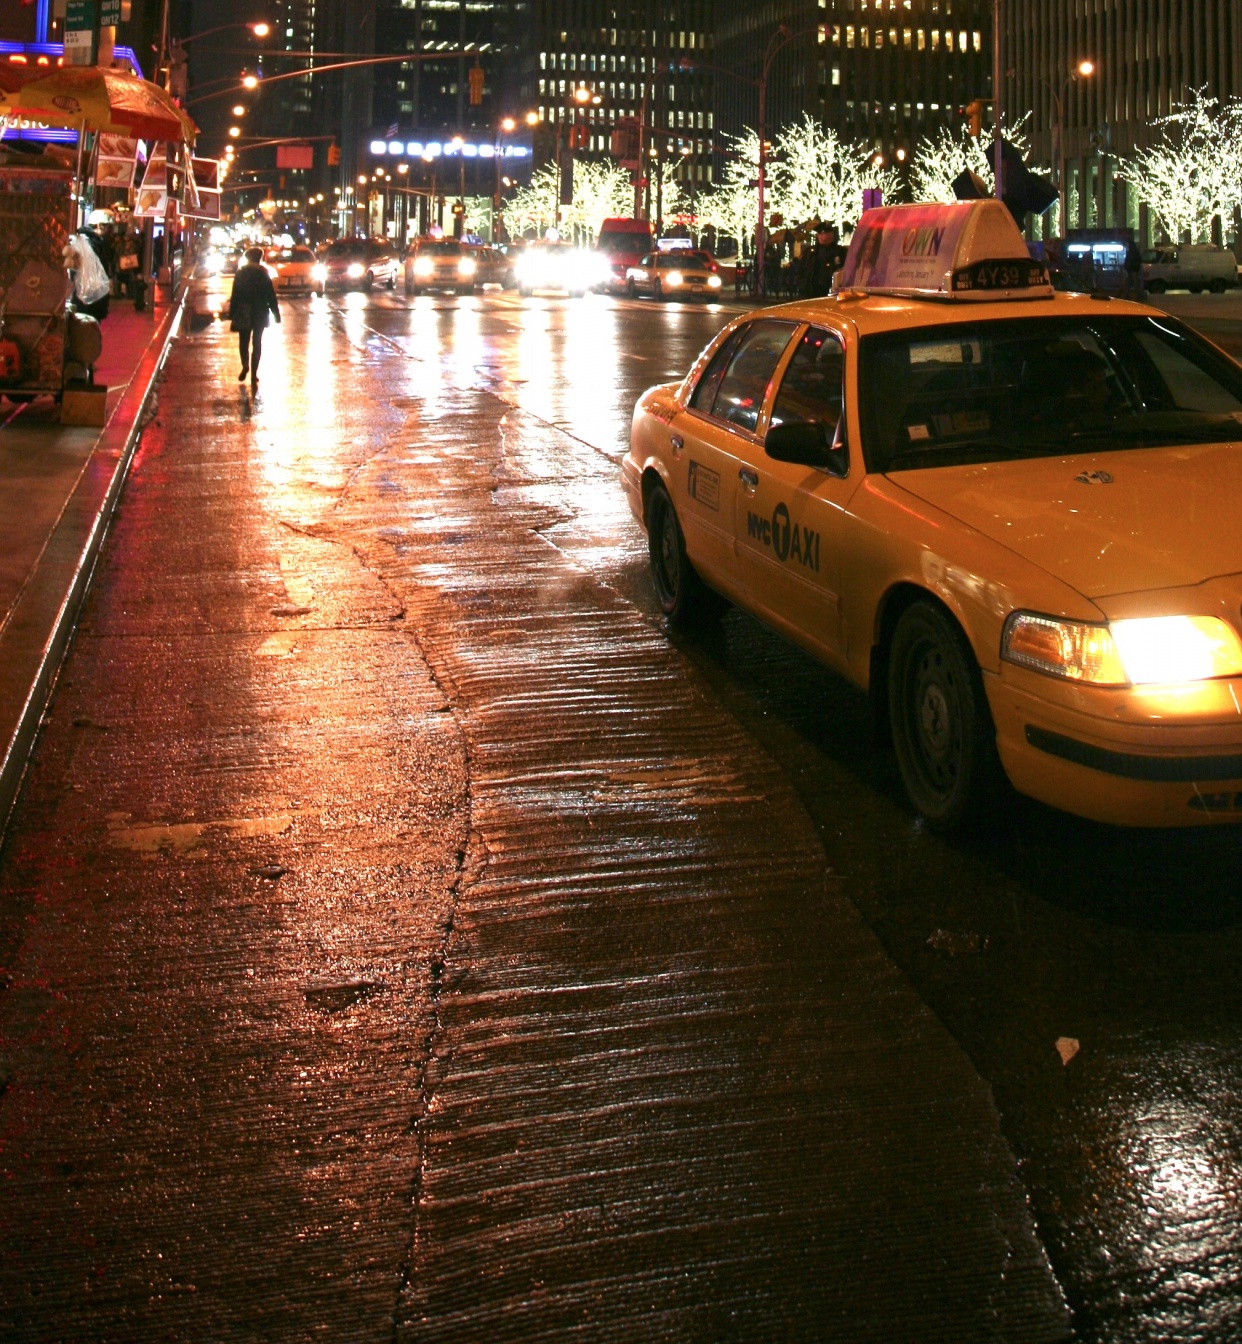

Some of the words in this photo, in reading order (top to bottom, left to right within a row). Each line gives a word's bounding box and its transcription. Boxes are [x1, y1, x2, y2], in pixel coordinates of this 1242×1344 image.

[101, 0, 120, 11] QM10
[100, 13, 119, 25] QM12
[902, 226, 946, 256] OWN
[977, 266, 1019, 285] 4Y39
[747, 510, 771, 546] NYC
[772, 503, 820, 573] TAXI
